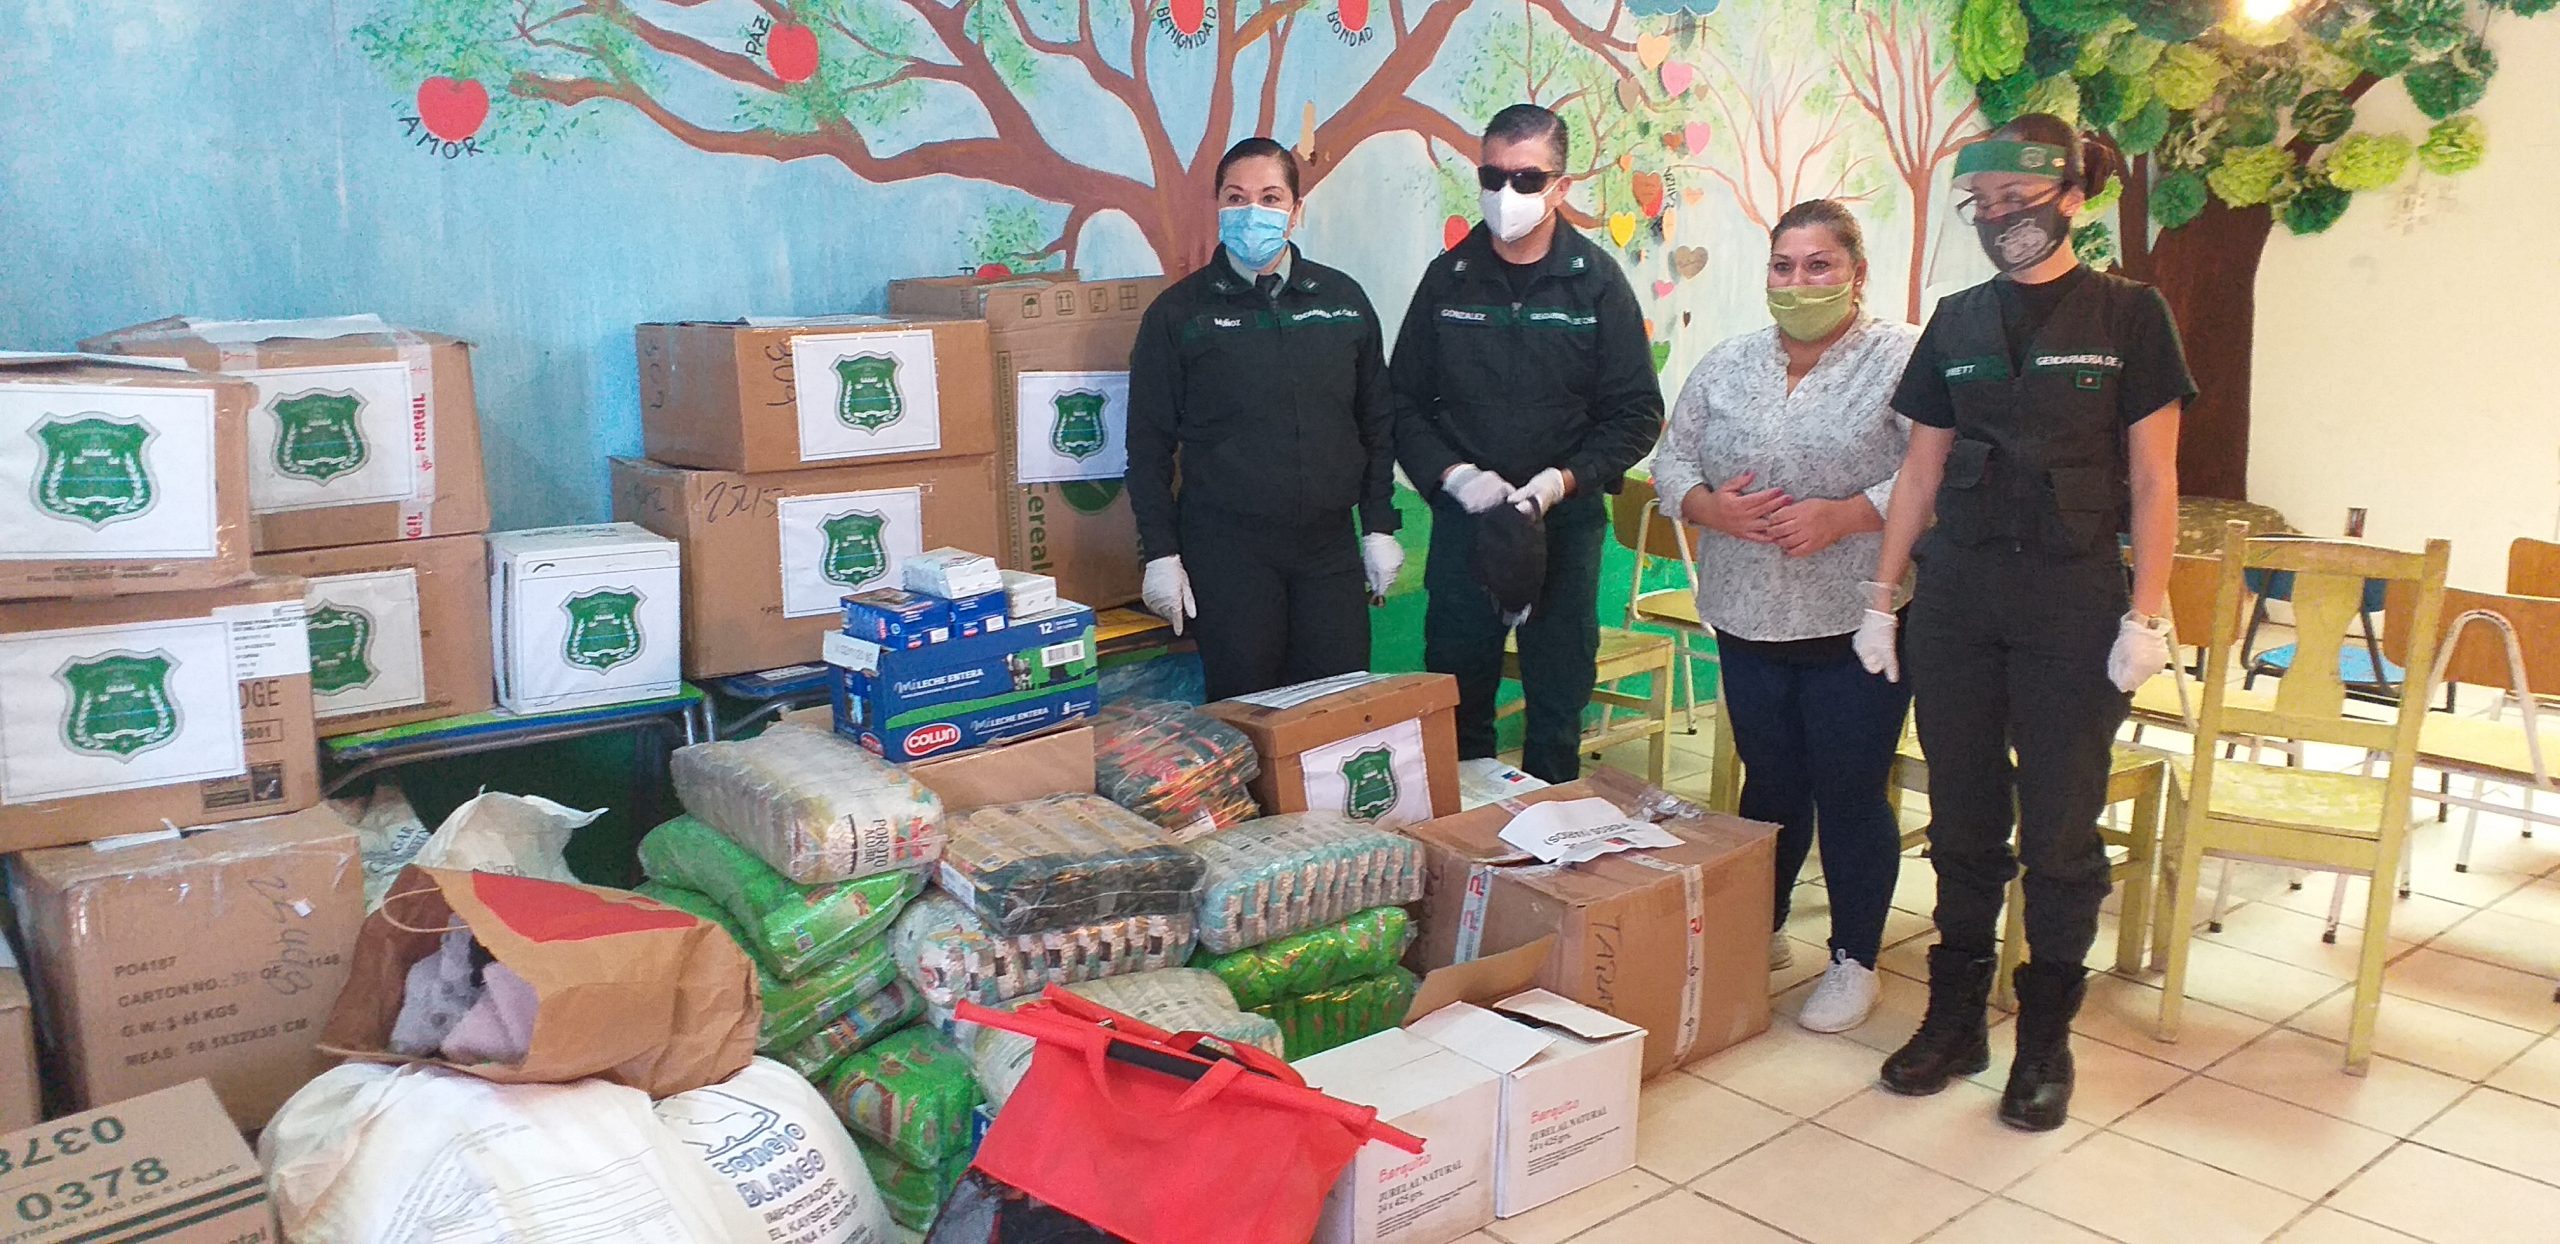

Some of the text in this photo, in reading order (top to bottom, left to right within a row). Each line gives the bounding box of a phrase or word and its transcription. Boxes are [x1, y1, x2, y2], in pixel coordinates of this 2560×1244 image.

[745, 15, 771, 56] PAZ
[1327, 10, 1373, 47] BONDAD
[397, 116, 484, 159] AMOR
[1027, 483, 1054, 574] ereal
[1037, 622, 1054, 635] 12
[917, 675, 947, 690] LECHE
[947, 668, 985, 684] ENTERA
[1017, 706, 1049, 721] ENTERA
[906, 725, 957, 749] COLUN
[873, 819, 890, 868] POROTO
[117, 985, 190, 1008] CARTON
[260, 964, 282, 980] OF
[16, 1157, 169, 1222] 0378
[177, 1163, 241, 1190] CAJAS
[735, 1148, 827, 1209] BLANCO
[763, 1176, 839, 1225] IMPORTADOR
[767, 1227, 788, 1242] EL
